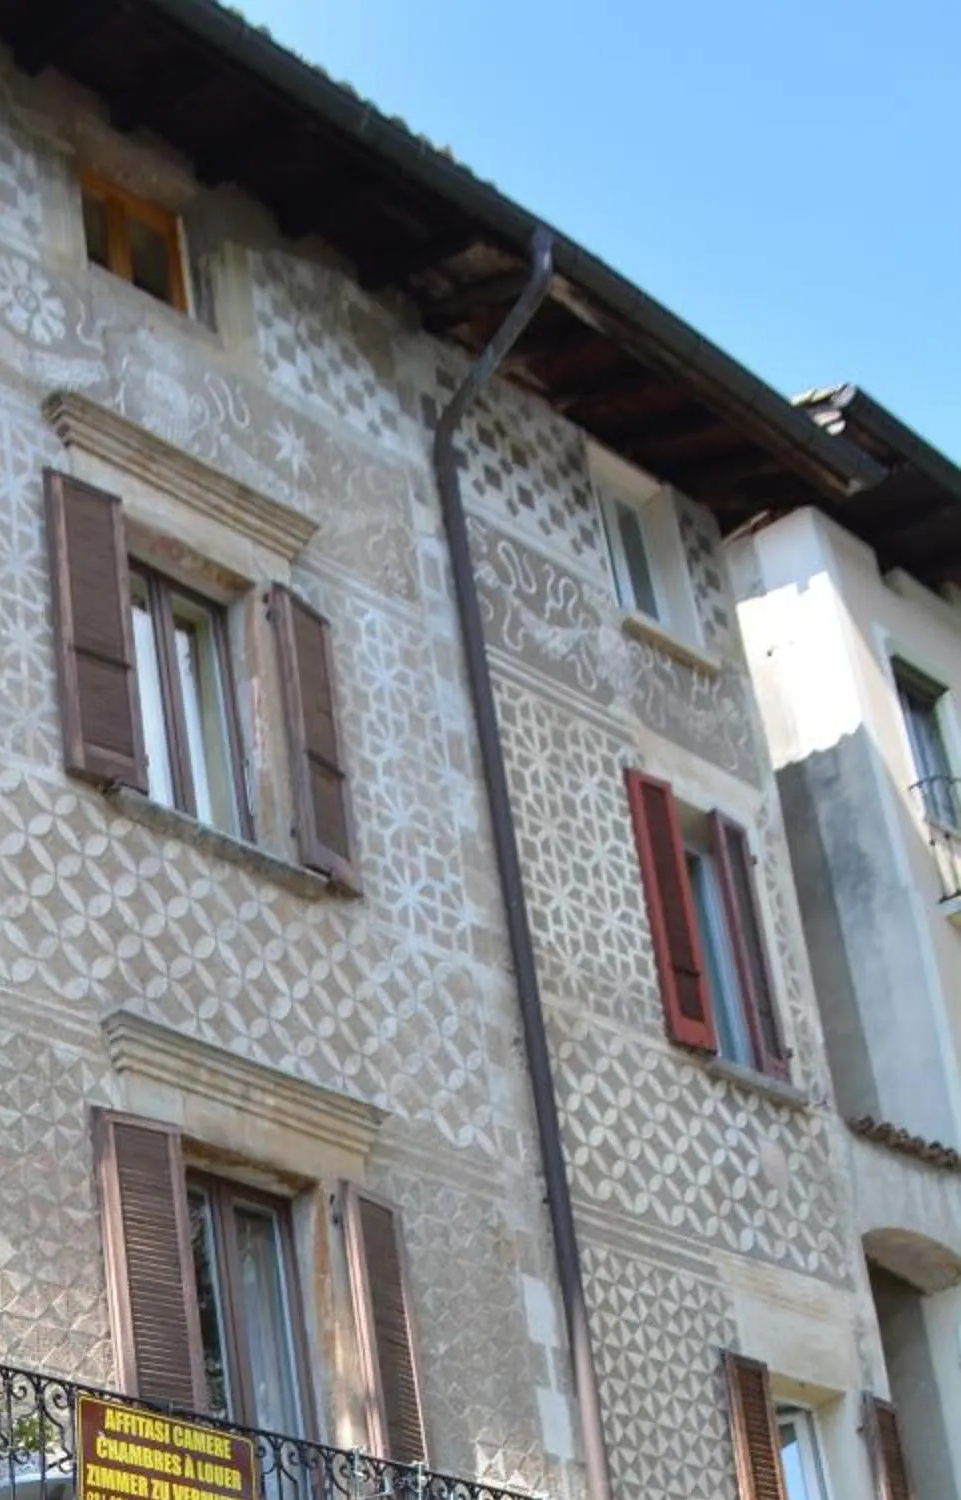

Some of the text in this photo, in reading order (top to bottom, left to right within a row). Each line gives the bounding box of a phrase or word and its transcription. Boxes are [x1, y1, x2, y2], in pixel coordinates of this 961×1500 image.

[104, 1409, 232, 1459] AFFITASI CAMERE
[86, 1464, 149, 1496] ZIMMER
[96, 1436, 182, 1477] CHAMBRES
[197, 1461, 242, 1490] LOUER
